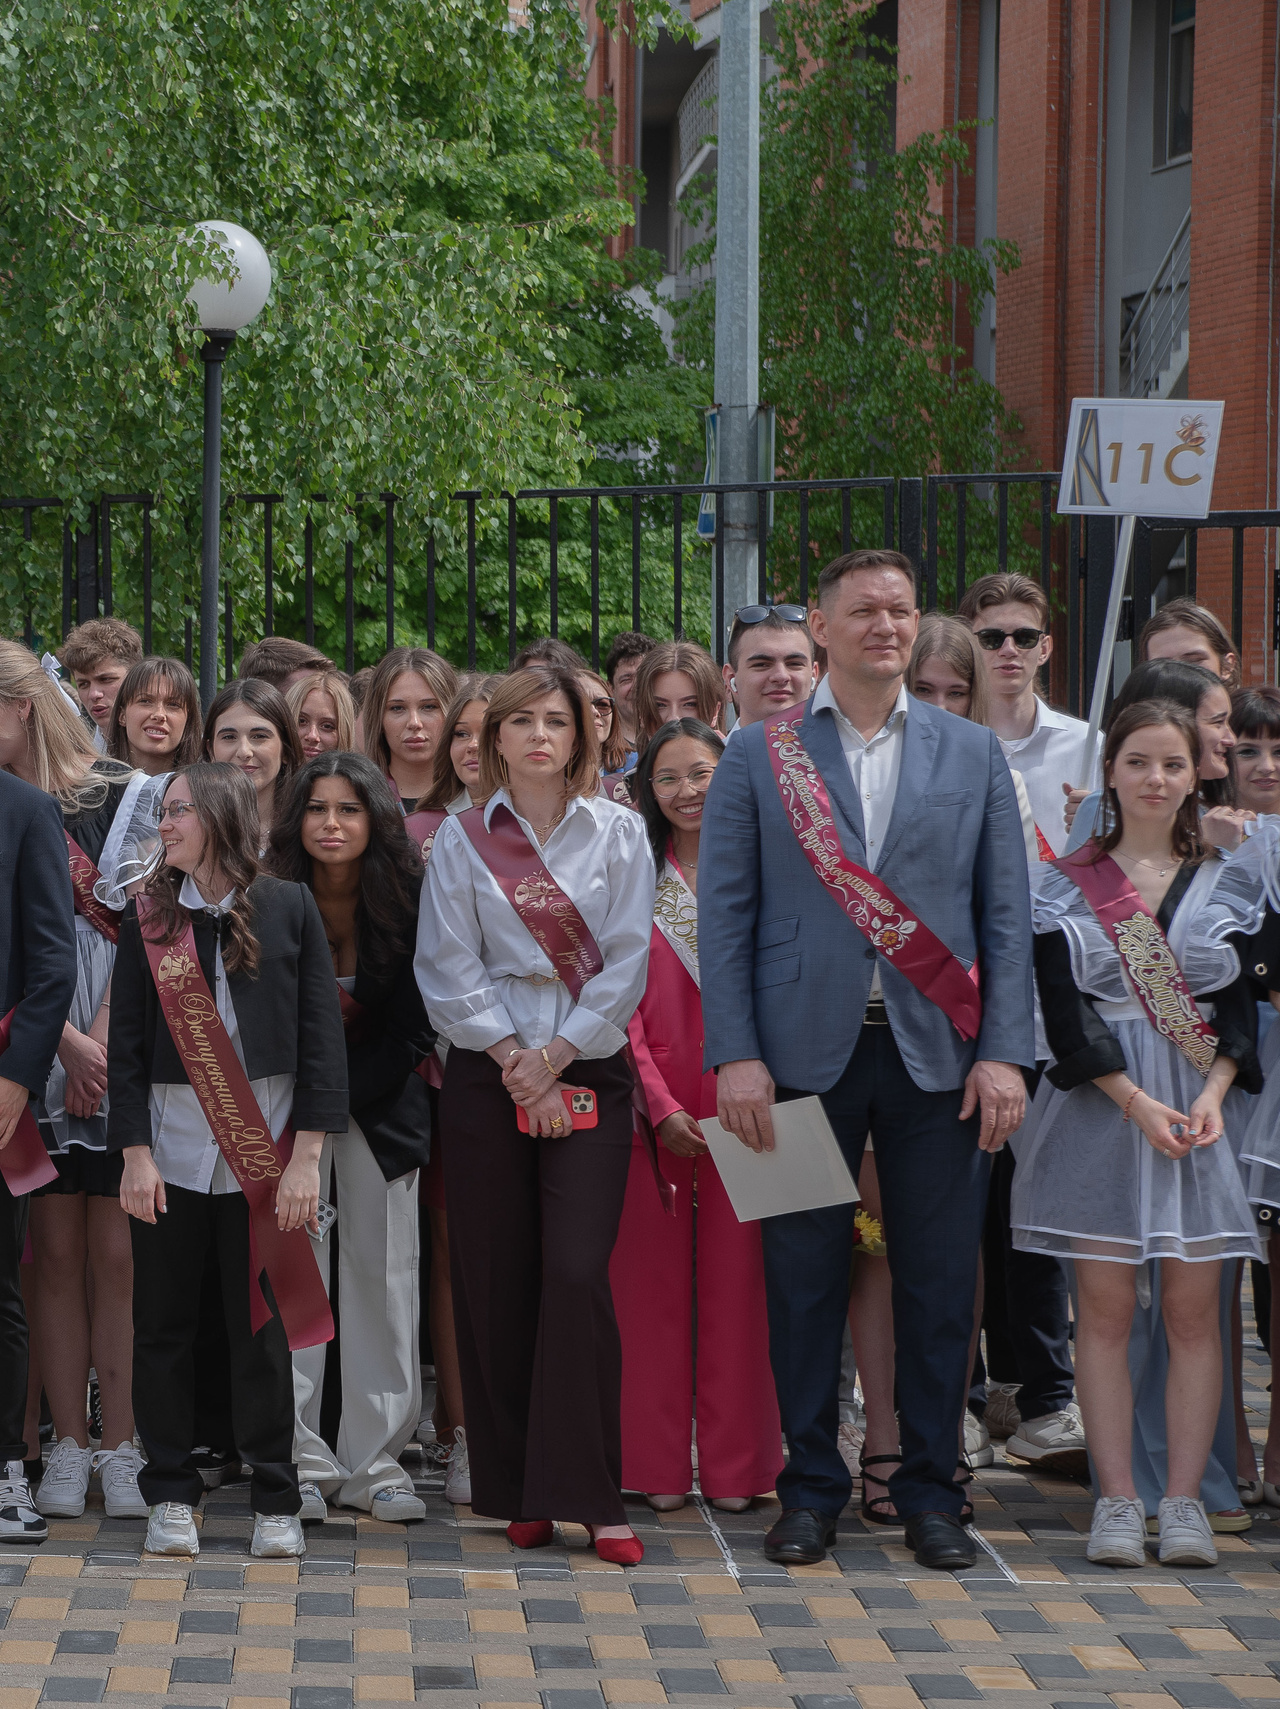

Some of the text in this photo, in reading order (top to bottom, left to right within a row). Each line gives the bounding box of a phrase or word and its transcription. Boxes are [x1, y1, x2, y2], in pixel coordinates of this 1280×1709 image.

[1107, 442, 1206, 487] 11С
[778, 743, 895, 916] Классный руководитель
[548, 902, 596, 970] Классный
[178, 993, 281, 1181] Выпускница 2023
